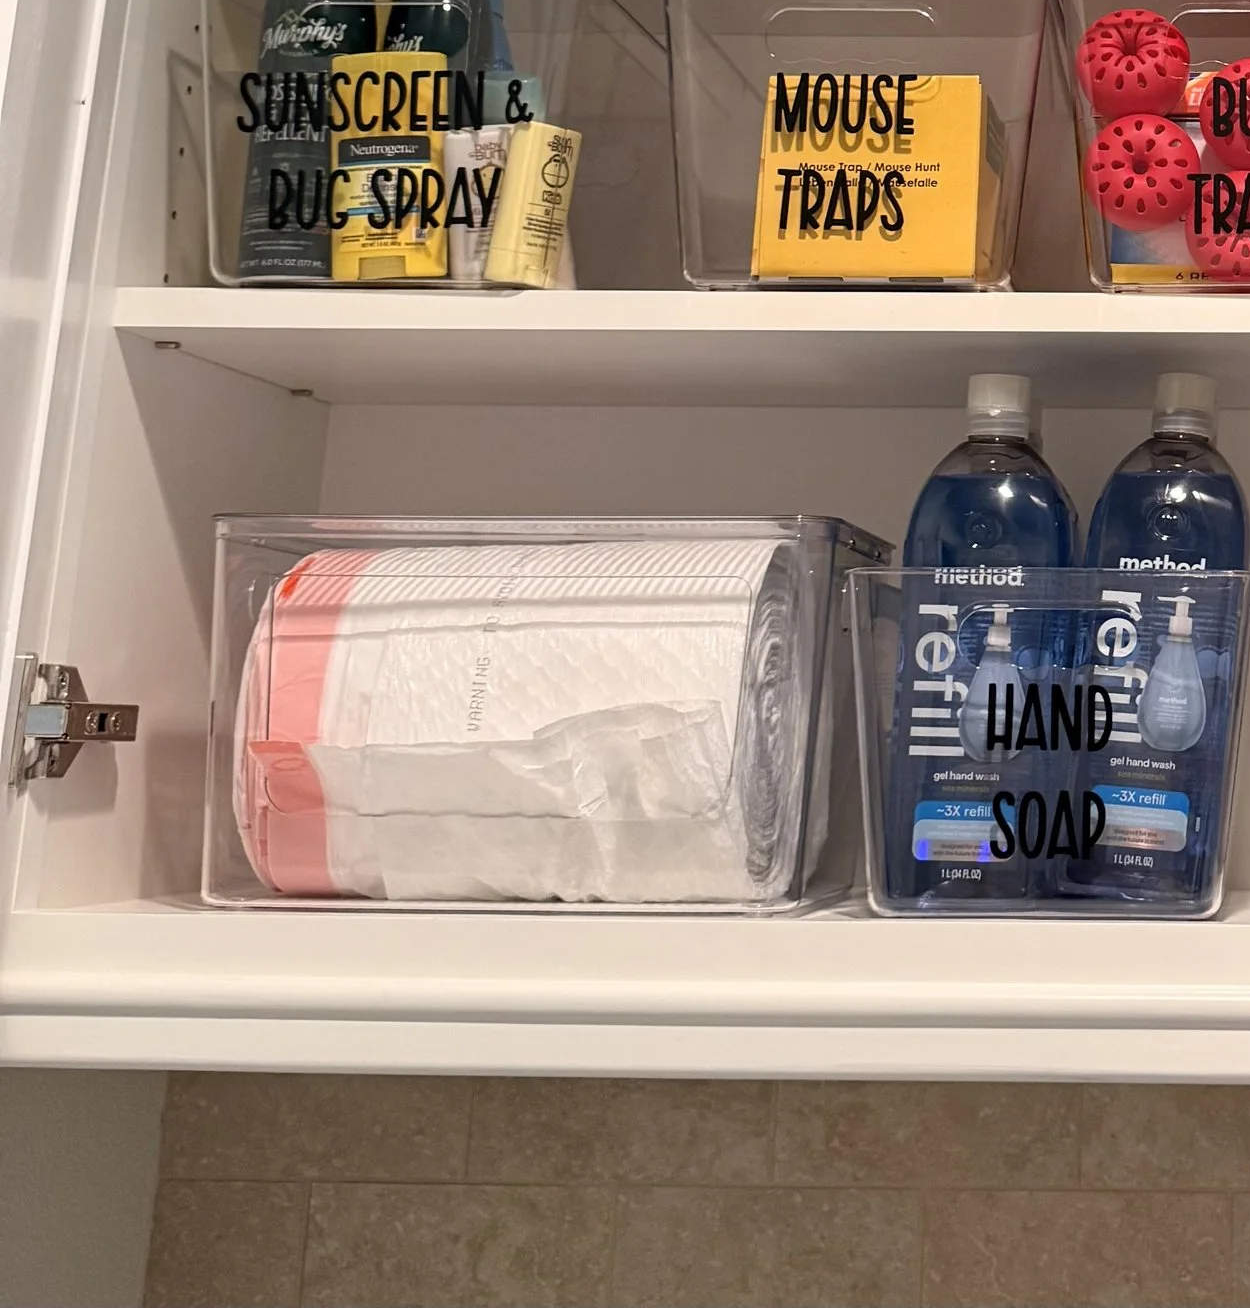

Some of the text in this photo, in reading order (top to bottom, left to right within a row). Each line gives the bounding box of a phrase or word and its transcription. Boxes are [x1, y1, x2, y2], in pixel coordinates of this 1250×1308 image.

[236, 70, 486, 133] SUNSCREEN
[504, 79, 534, 124] &
[774, 72, 918, 135] MOUSE
[799, 162, 836, 172] Mouse
[839, 162, 863, 174] Trap
[874, 162, 912, 172] Mouse
[915, 162, 941, 172] Hunt
[268, 168, 351, 230] BUG
[367, 167, 503, 229] SPRAY
[777, 168, 905, 232] TRAPS
[1175, 271, 1184, 281] 6
[908, 604, 969, 757] refill
[1094, 590, 1149, 743] refill
[986, 683, 1113, 753] HAND
[933, 771, 1000, 782] gel hand wash
[1110, 756, 1176, 770] gel hand wash
[937, 805, 991, 817] ~3X refill
[1112, 790, 1166, 806] ~3X refill
[989, 789, 1107, 861] SOAP
[946, 869, 950, 878] L
[1118, 854, 1123, 864] L
